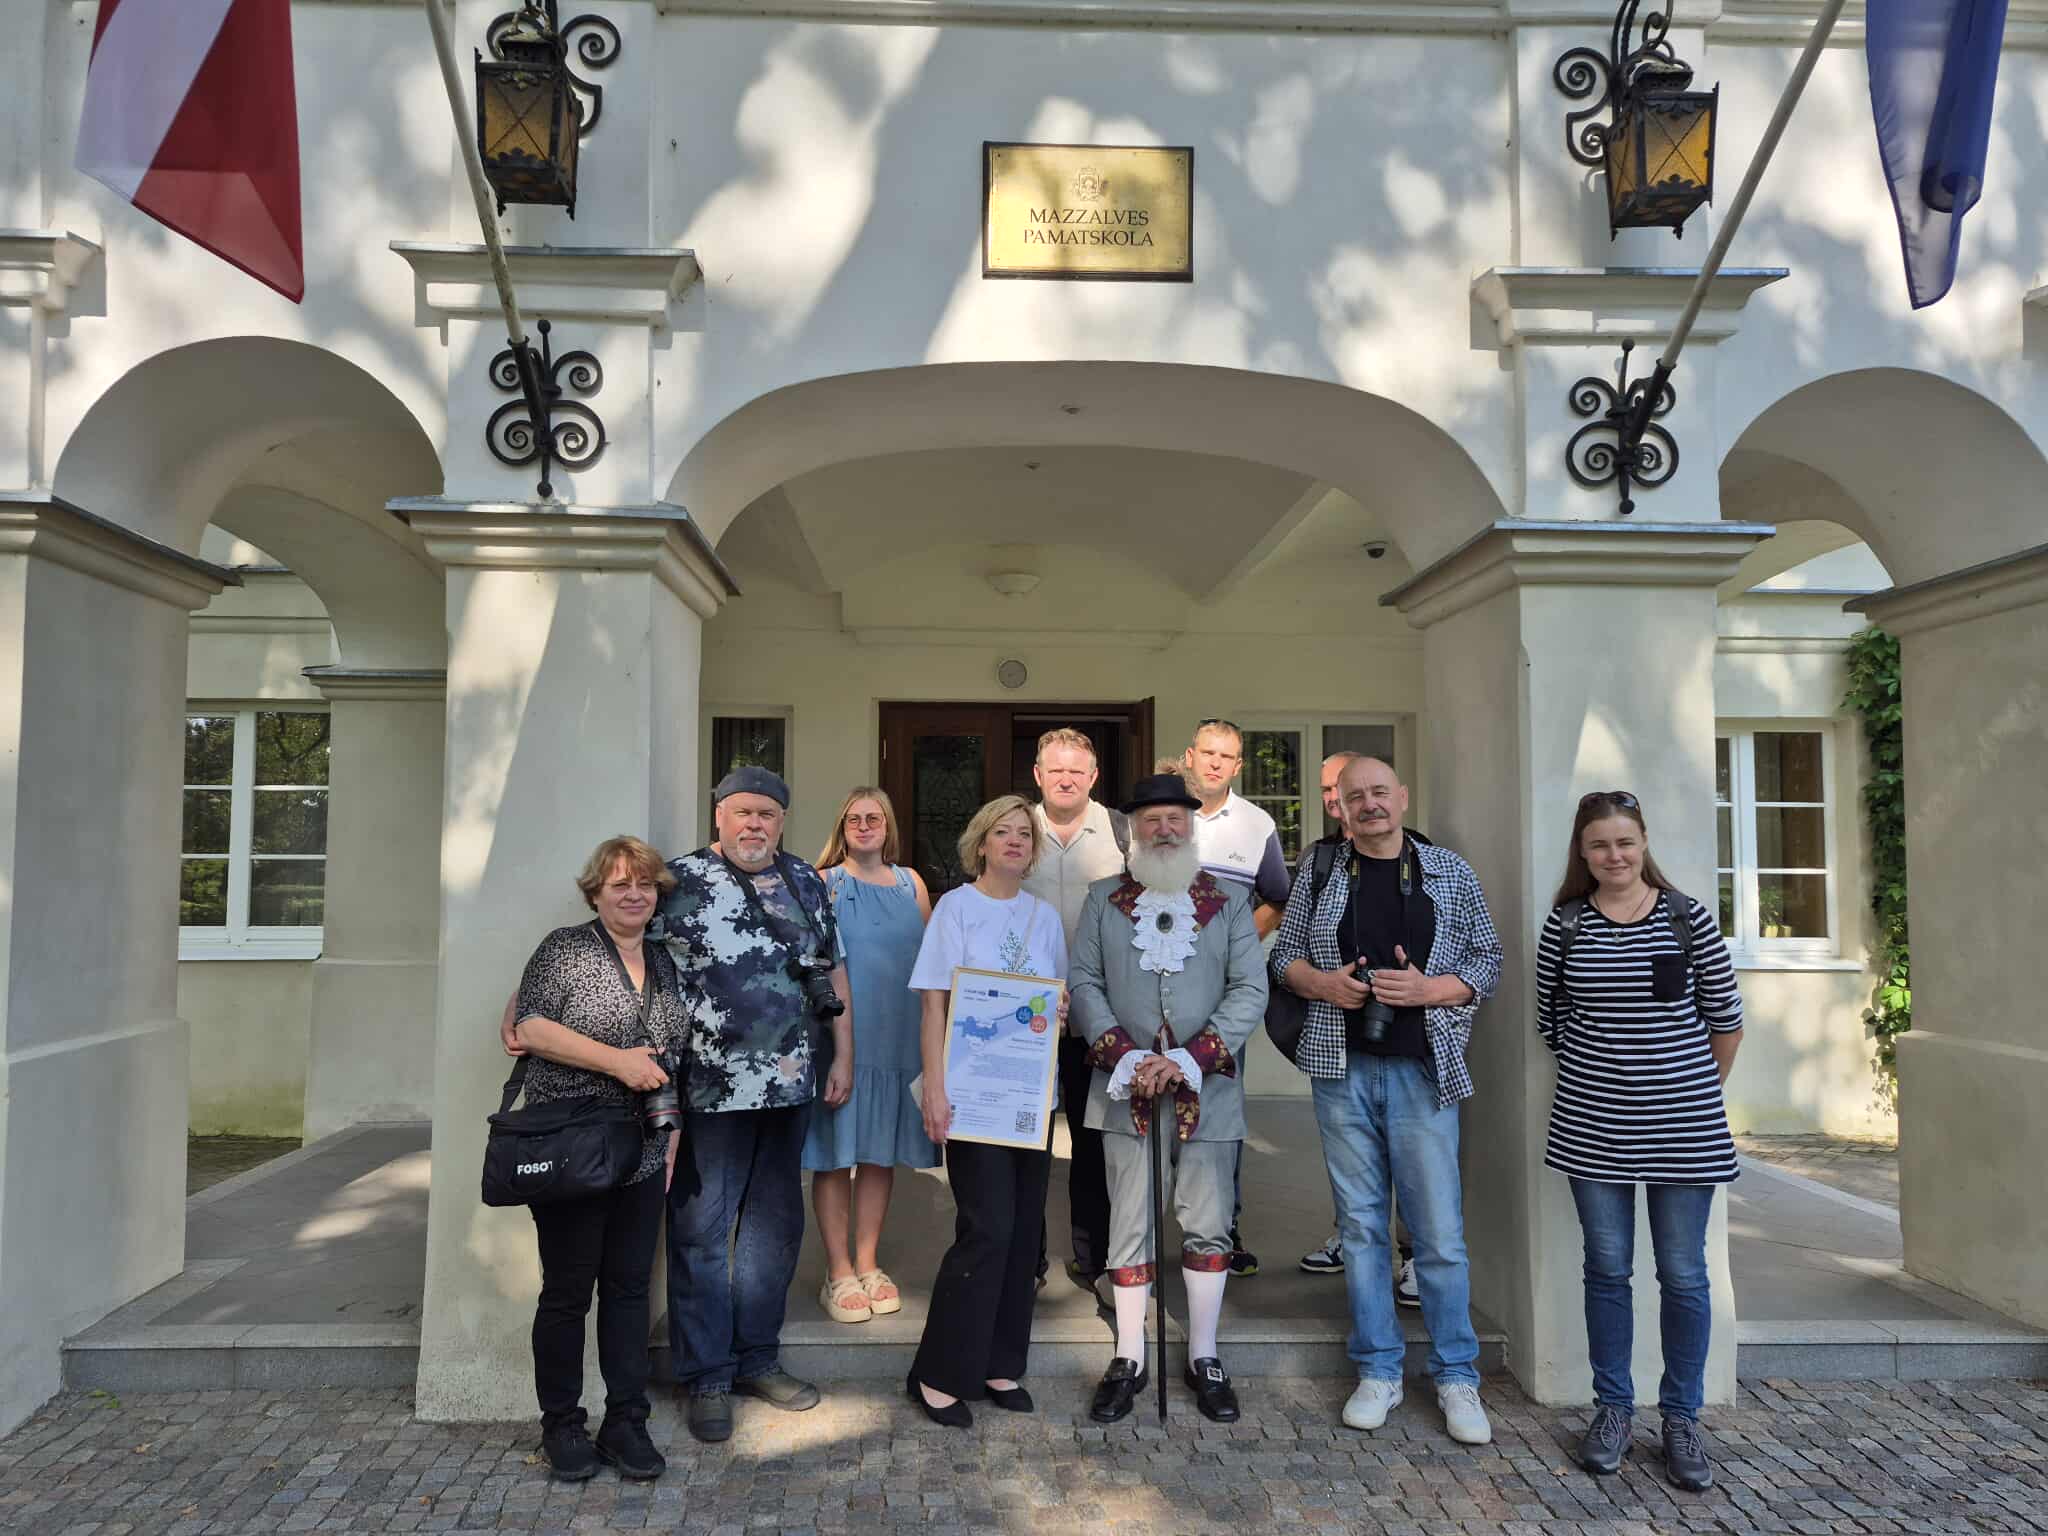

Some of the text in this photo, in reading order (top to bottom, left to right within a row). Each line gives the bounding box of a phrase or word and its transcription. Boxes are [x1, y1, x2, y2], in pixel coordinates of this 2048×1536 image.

[1030, 208, 1149, 225] MAZZALVES
[1024, 229, 1153, 247] PAMATSKOLA
[517, 1159, 568, 1175] FOSOT
